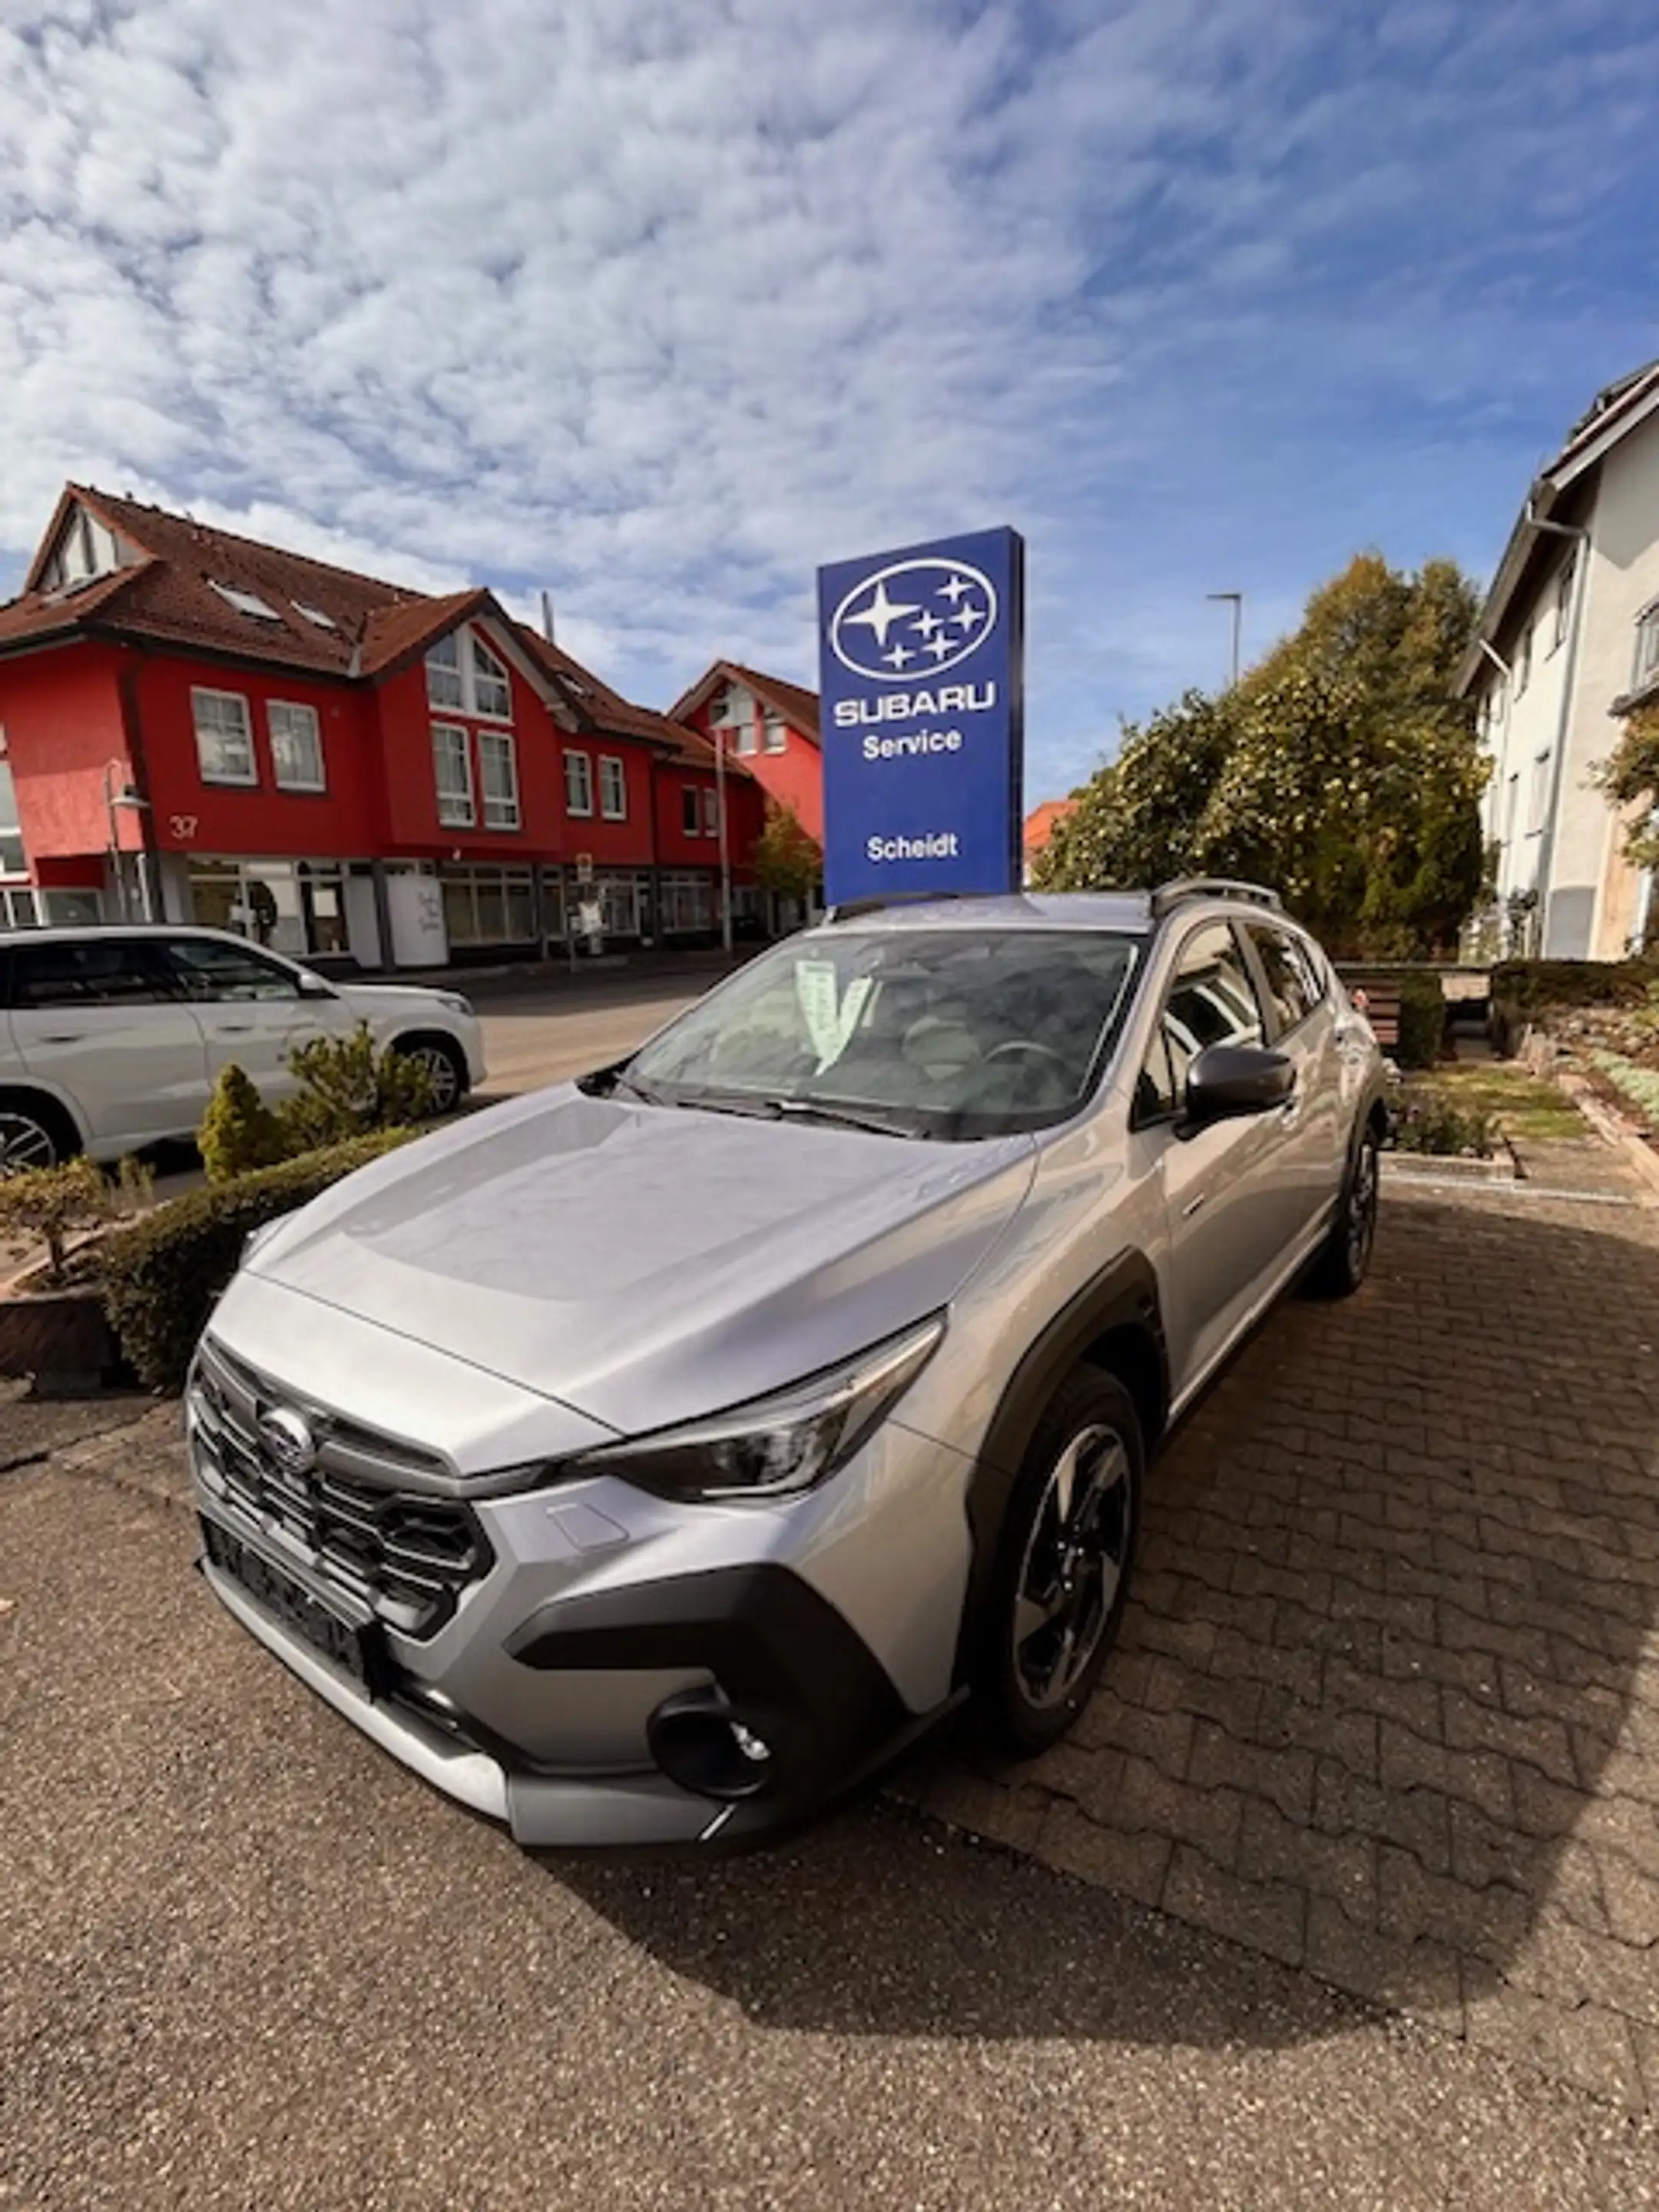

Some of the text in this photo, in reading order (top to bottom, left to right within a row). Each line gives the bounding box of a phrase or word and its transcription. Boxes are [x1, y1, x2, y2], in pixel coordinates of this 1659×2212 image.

[834, 680, 996, 727] SUBARU
[863, 729, 962, 760] Service
[169, 815, 198, 839] 37
[866, 833, 959, 861] Scheidt
